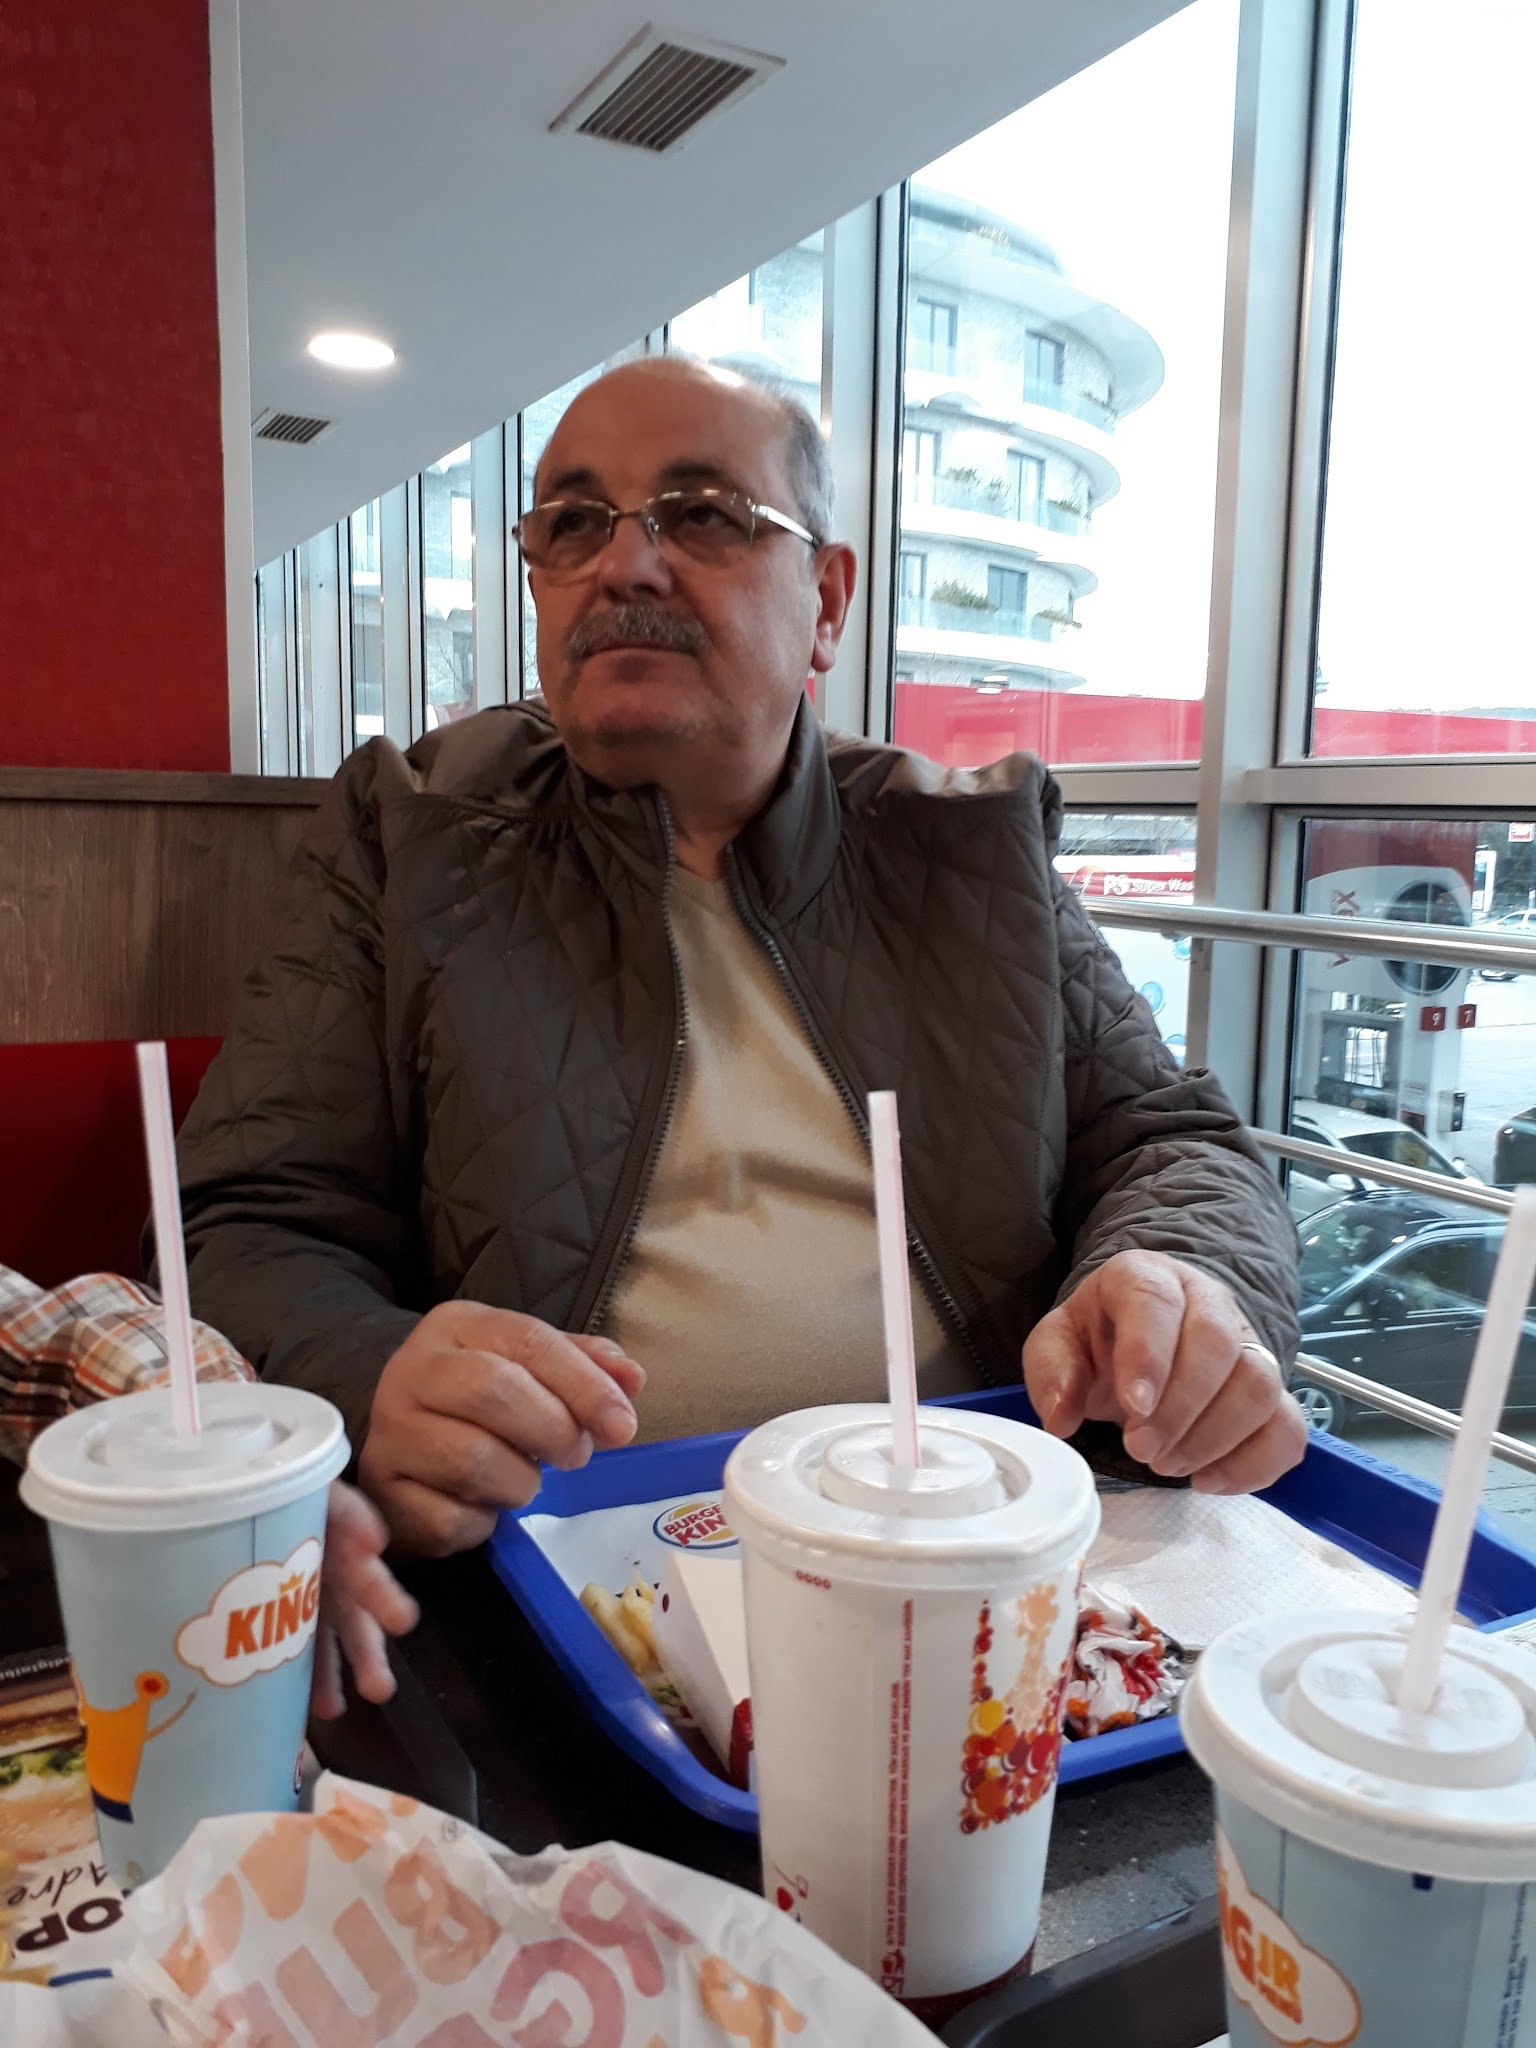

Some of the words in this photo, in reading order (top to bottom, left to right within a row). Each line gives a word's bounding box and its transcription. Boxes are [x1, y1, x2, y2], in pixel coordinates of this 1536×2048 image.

[1168, 878, 1195, 892] Was
[1463, 1009, 1473, 1024] 7
[662, 1504, 722, 1536] BURGE
[674, 1514, 728, 1546] KIN
